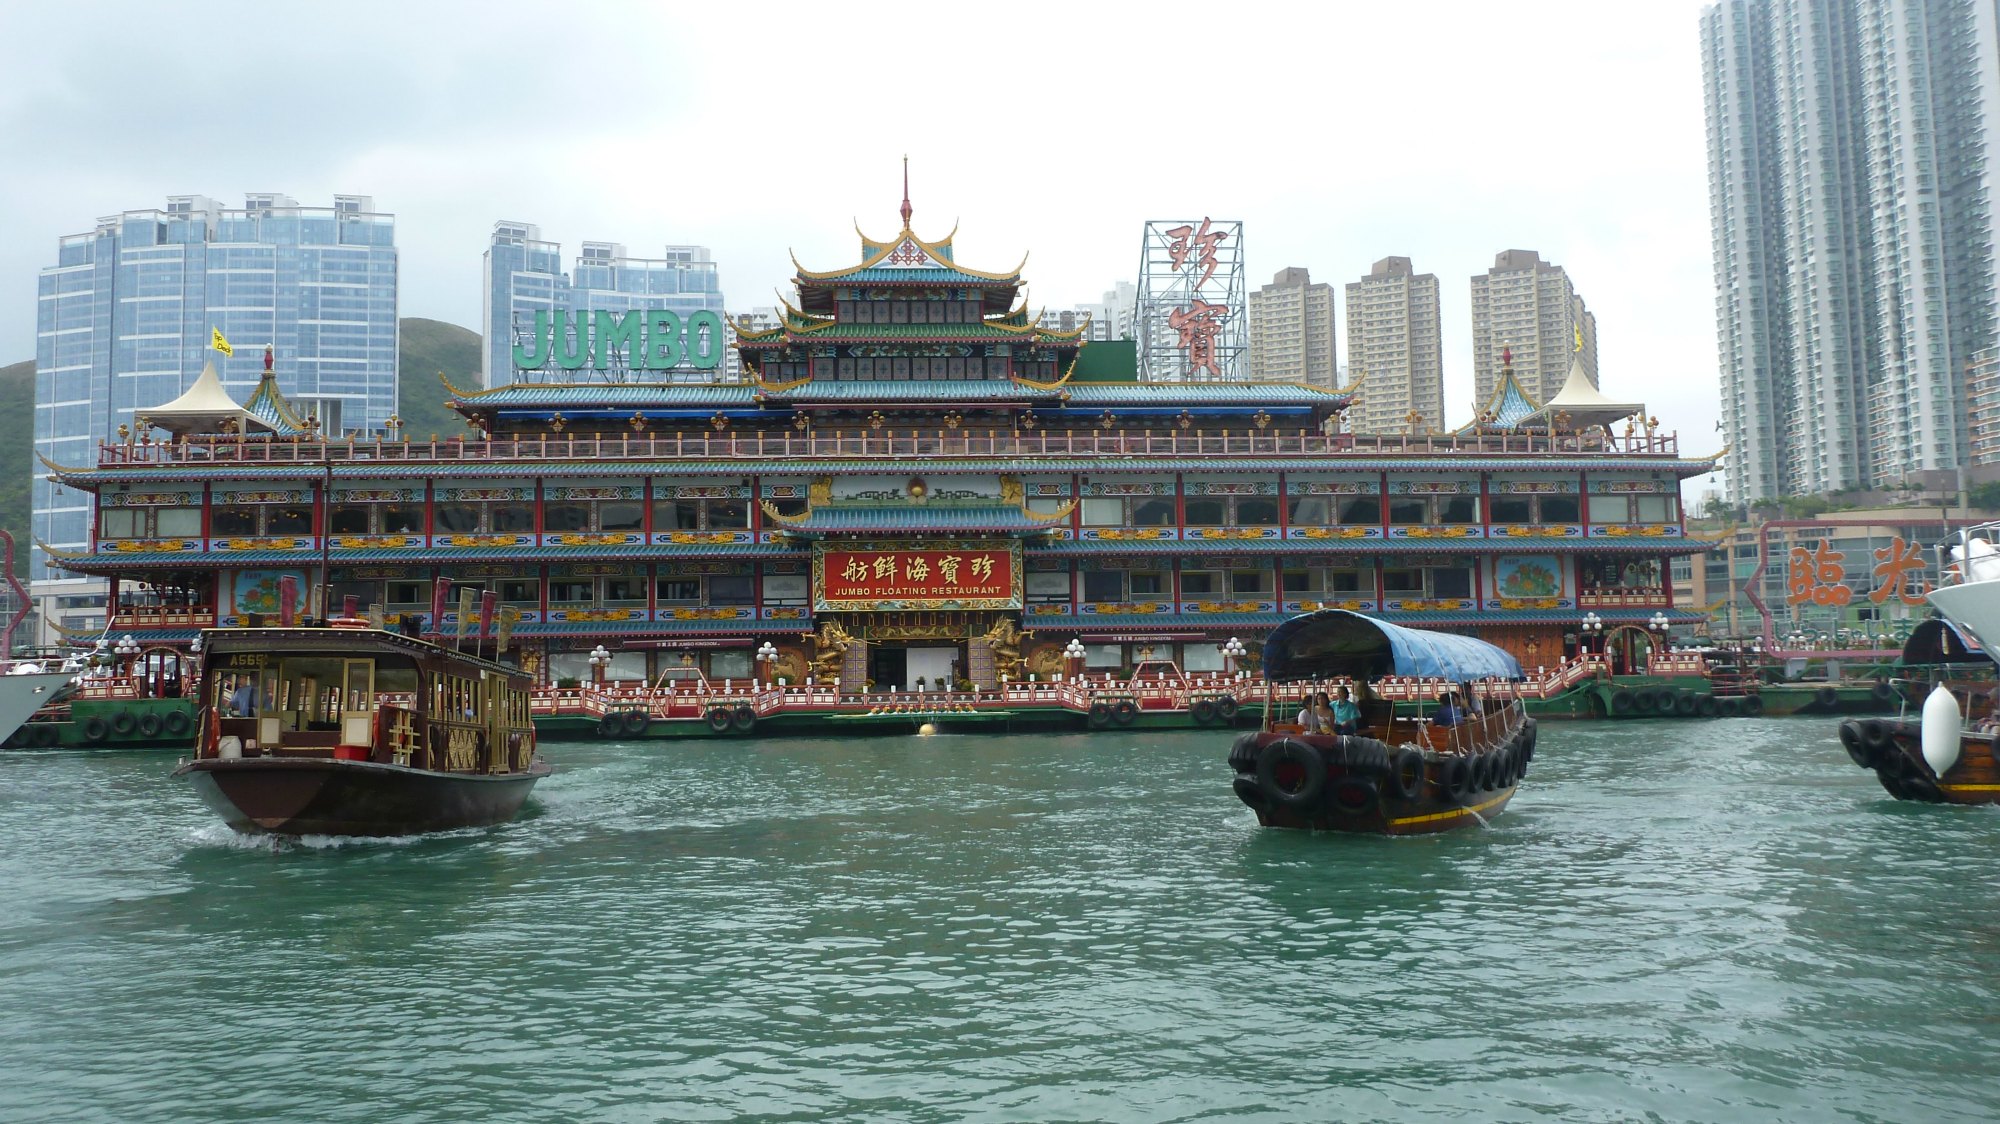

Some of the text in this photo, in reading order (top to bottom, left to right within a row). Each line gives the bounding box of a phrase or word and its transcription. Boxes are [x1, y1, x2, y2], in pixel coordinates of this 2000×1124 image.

[1166, 216, 1229, 376] 珍寶
[512, 310, 723, 369] JUMBO
[835, 586, 1001, 596] JUMBO FLOATING RESTAURANT
[1786, 536, 1963, 607] 光臨
